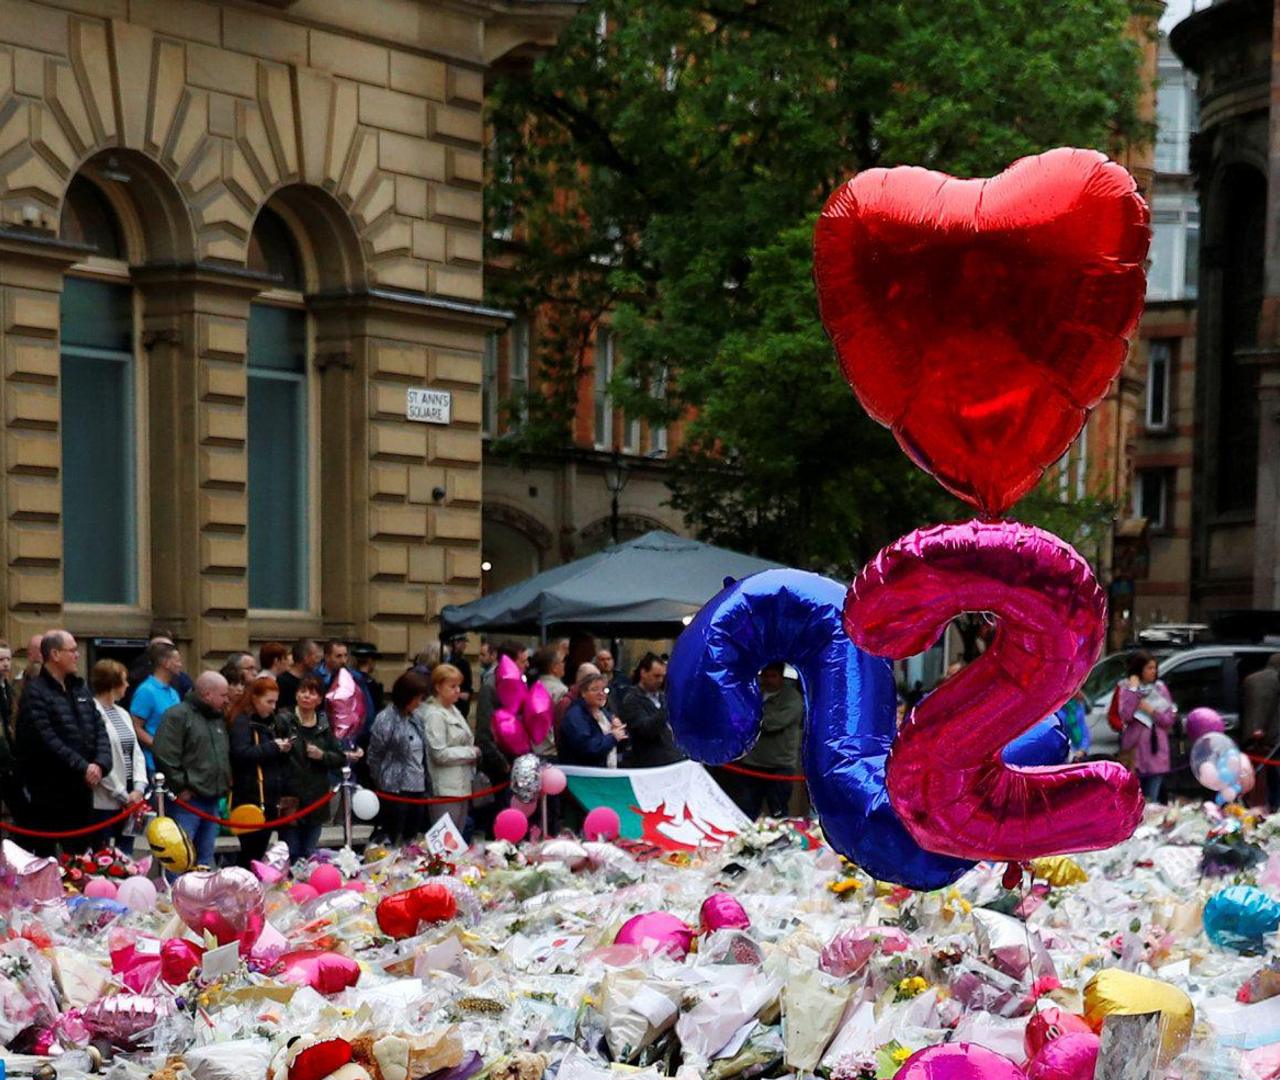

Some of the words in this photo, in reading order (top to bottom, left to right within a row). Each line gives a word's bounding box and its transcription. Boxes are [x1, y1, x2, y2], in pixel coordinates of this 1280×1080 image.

[409, 391, 418, 404] ST
[422, 392, 449, 408] ANN'S
[409, 405, 443, 420] SQUARE
